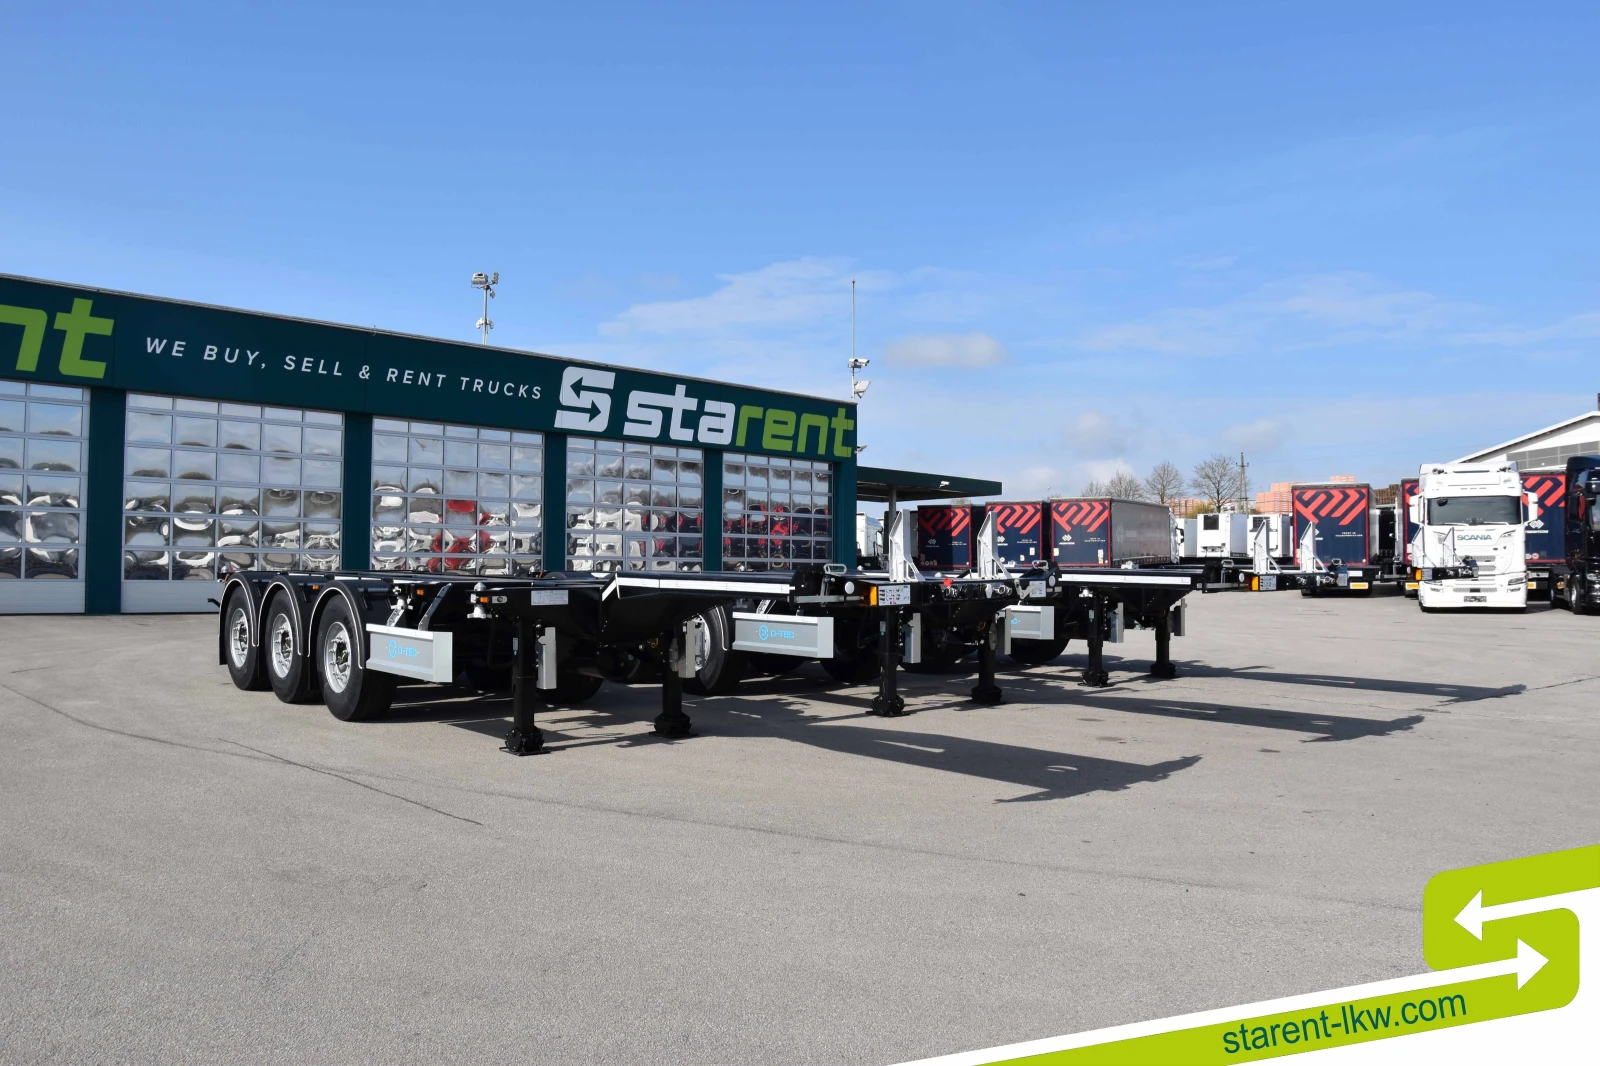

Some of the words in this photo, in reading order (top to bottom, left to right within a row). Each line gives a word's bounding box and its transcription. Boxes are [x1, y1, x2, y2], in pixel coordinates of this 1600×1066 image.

[146, 337, 186, 357] WE
[203, 344, 267, 369] BUY,
[284, 355, 342, 376] SELL
[358, 364, 372, 380] &
[386, 368, 447, 388] RENT
[460, 376, 541, 400] TRUCKS
[623, 384, 854, 458] starent
